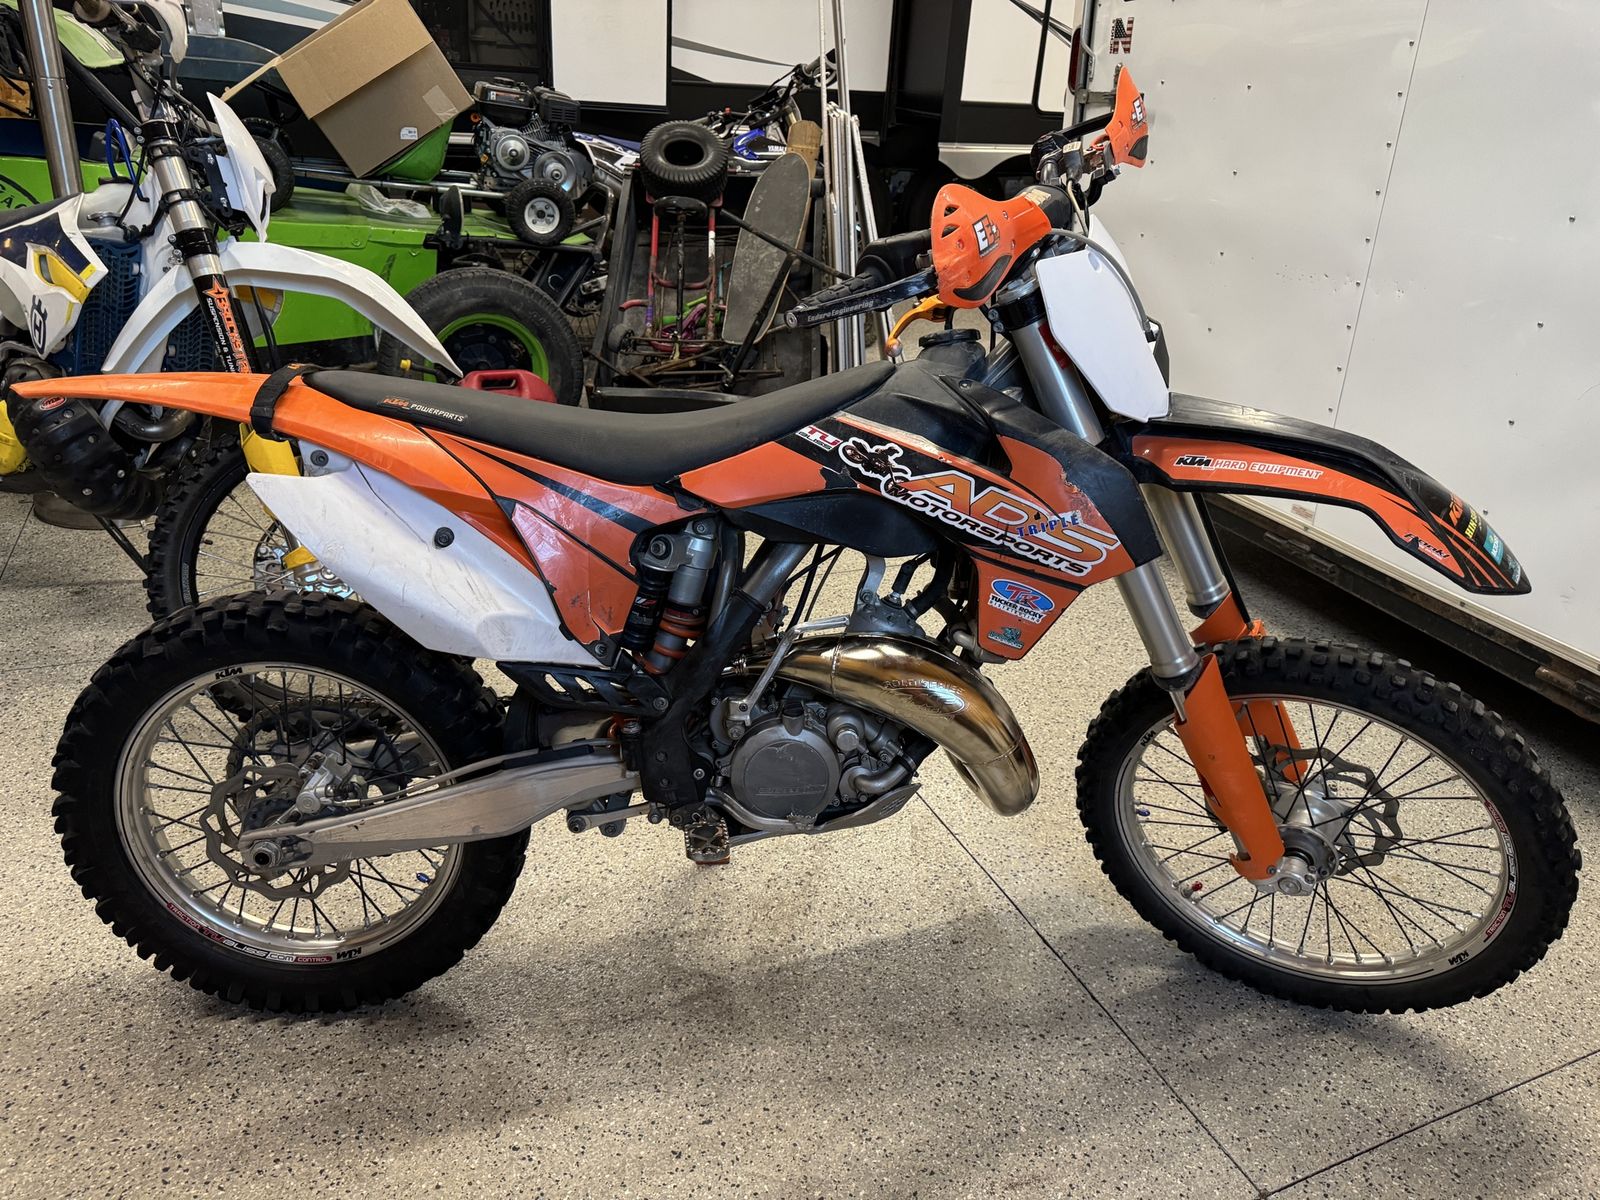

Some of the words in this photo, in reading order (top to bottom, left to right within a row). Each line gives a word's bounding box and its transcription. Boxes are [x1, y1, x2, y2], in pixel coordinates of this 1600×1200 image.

[206, 298, 226, 346] SUSPENSION
[410, 403, 465, 422] POWERPARTS
[1176, 455, 1212, 467] KTM
[1211, 458, 1247, 471] HARD
[889, 486, 1090, 575] MOTORSPORTS
[1016, 512, 1080, 539] TRIPLE
[991, 595, 1019, 611] TUCKER
[1018, 606, 1044, 620] ROCKY
[215, 666, 243, 680] KTM
